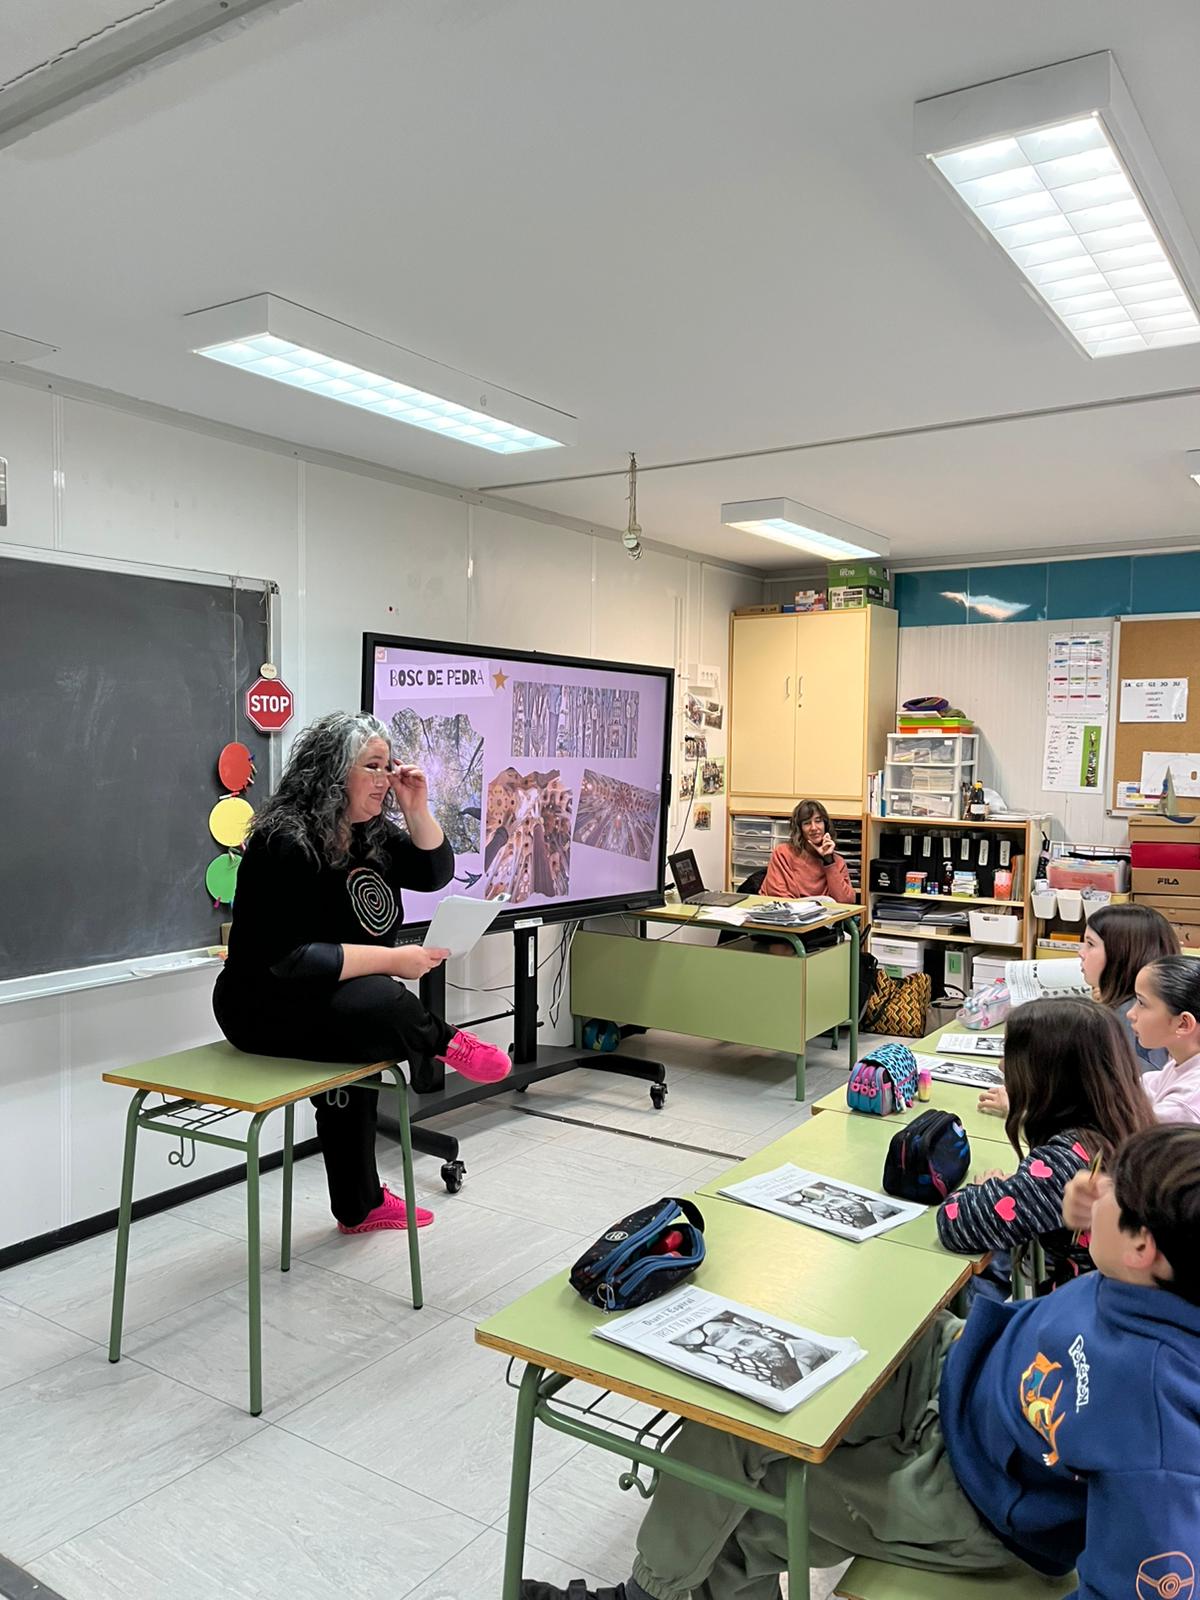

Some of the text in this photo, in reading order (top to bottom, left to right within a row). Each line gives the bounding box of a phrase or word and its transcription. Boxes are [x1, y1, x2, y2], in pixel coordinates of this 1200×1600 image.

[390, 669, 485, 687] BOSC DE PEDRA
[250, 694, 290, 713] STOP
[1157, 877, 1179, 885] FILA
